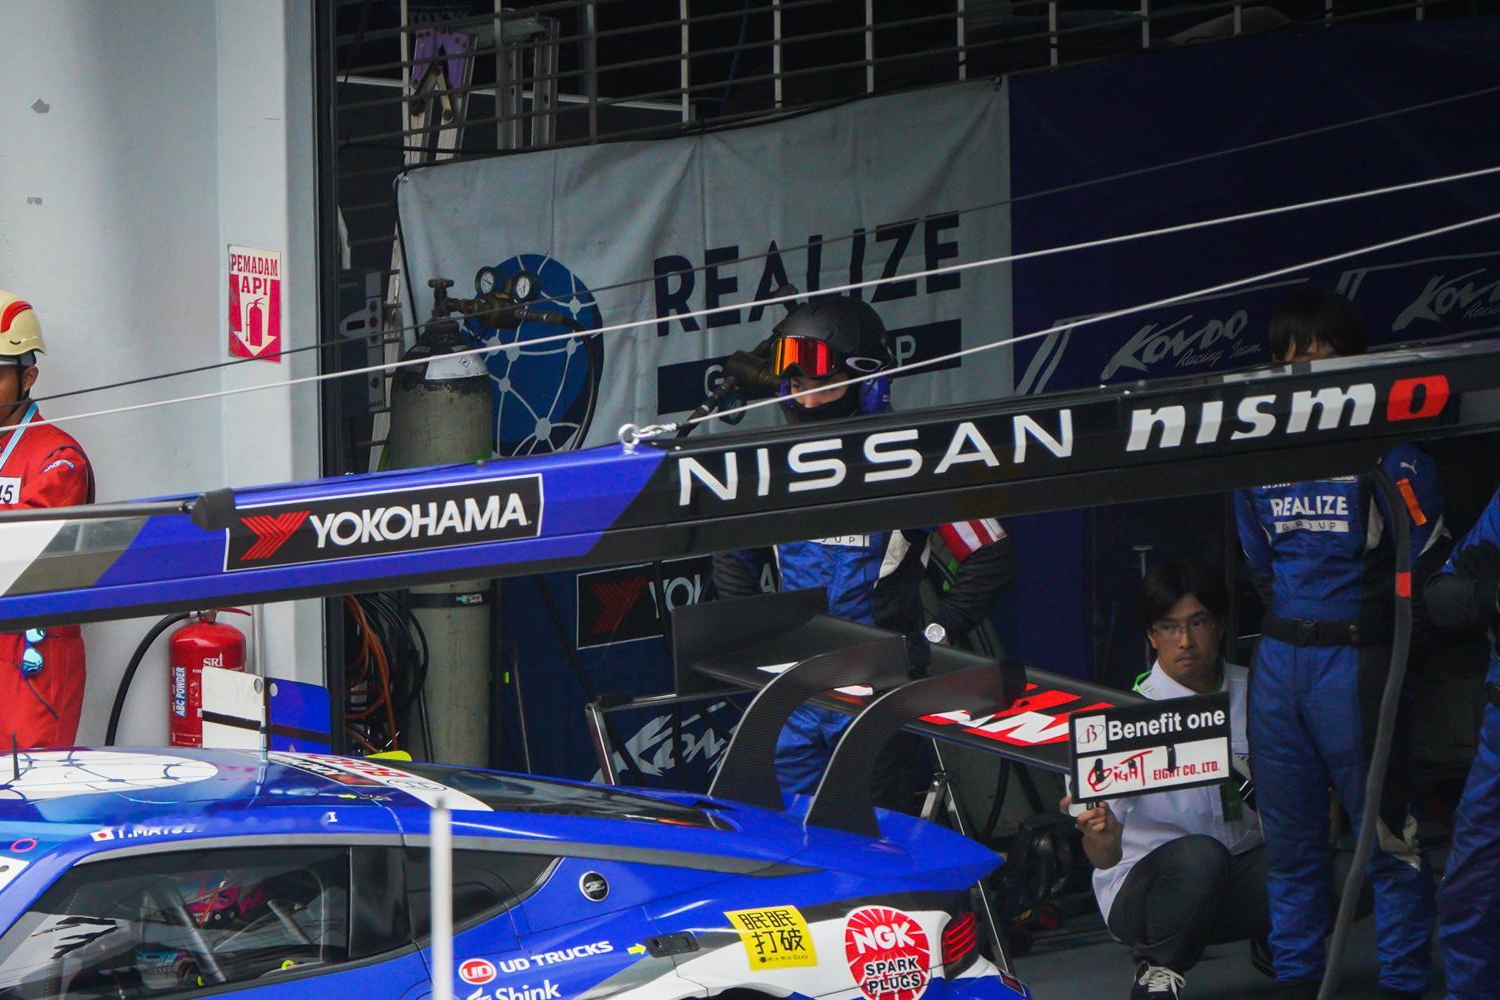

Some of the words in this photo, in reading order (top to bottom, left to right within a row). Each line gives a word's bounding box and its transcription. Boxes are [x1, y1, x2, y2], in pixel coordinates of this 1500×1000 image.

[230, 252, 279, 276] PEMADAM
[653, 212, 962, 337] REALIZE
[240, 275, 270, 296] API
[678, 407, 1073, 507] NISSAN
[1126, 373, 1450, 453] nismo
[1270, 495, 1349, 517] REALIZE
[309, 492, 527, 549] YOKOHAMA
[175, 666, 186, 698] POWDER
[175, 698, 186, 717] ABC
[1108, 713, 1182, 742] Benefit
[1187, 709, 1226, 730] one
[738, 909, 797, 930] 眠眠
[751, 928, 806, 955] 打破
[852, 922, 916, 954] NGK
[500, 957, 532, 975] UD
[532, 940, 614, 968] TRUCKS
[865, 956, 919, 976] SPARK
[868, 973, 922, 994] PLUGS
